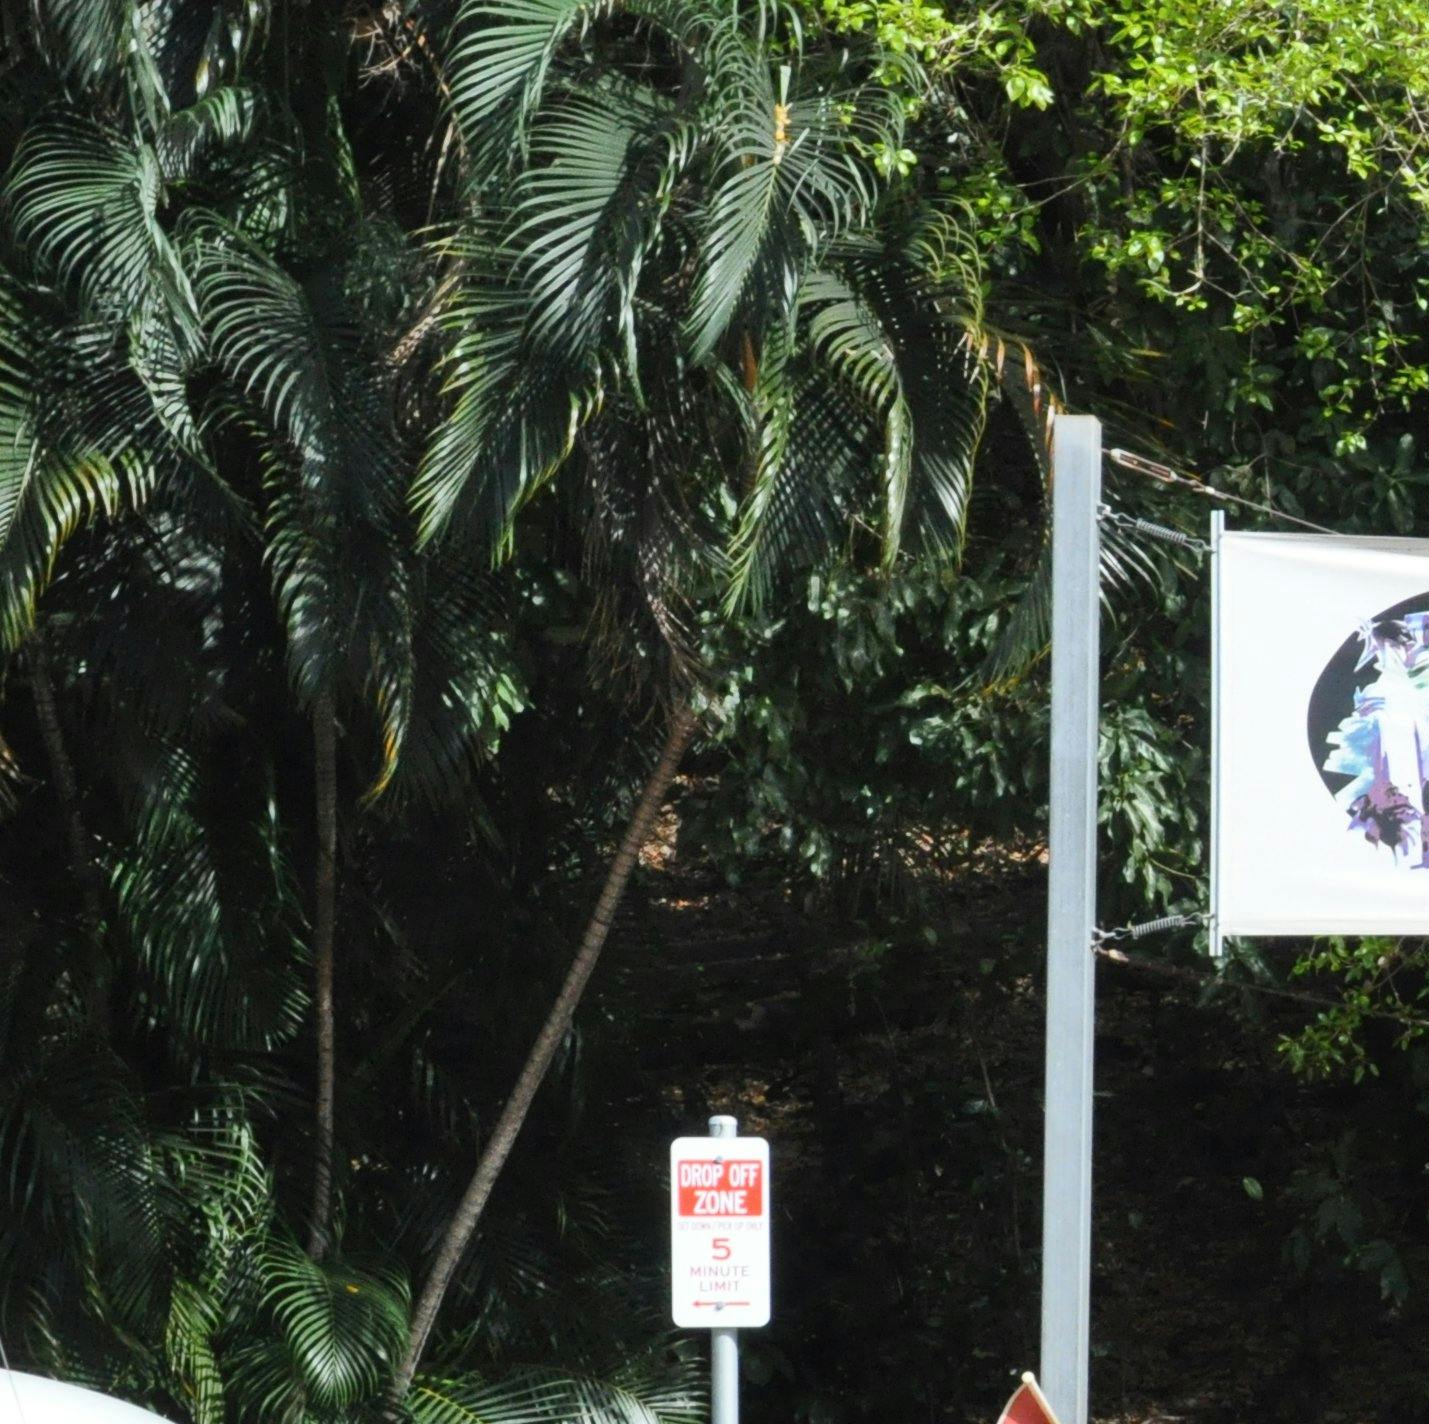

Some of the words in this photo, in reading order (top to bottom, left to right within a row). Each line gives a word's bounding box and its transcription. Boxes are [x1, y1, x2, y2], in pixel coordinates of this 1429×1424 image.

[680, 1163, 723, 1188] DROP
[728, 1163, 759, 1188] OFF
[693, 1190, 748, 1215] ZONE
[711, 1237, 732, 1261] 5
[689, 1265, 750, 1277] MINUTE
[699, 1280, 741, 1292] LIMIT
